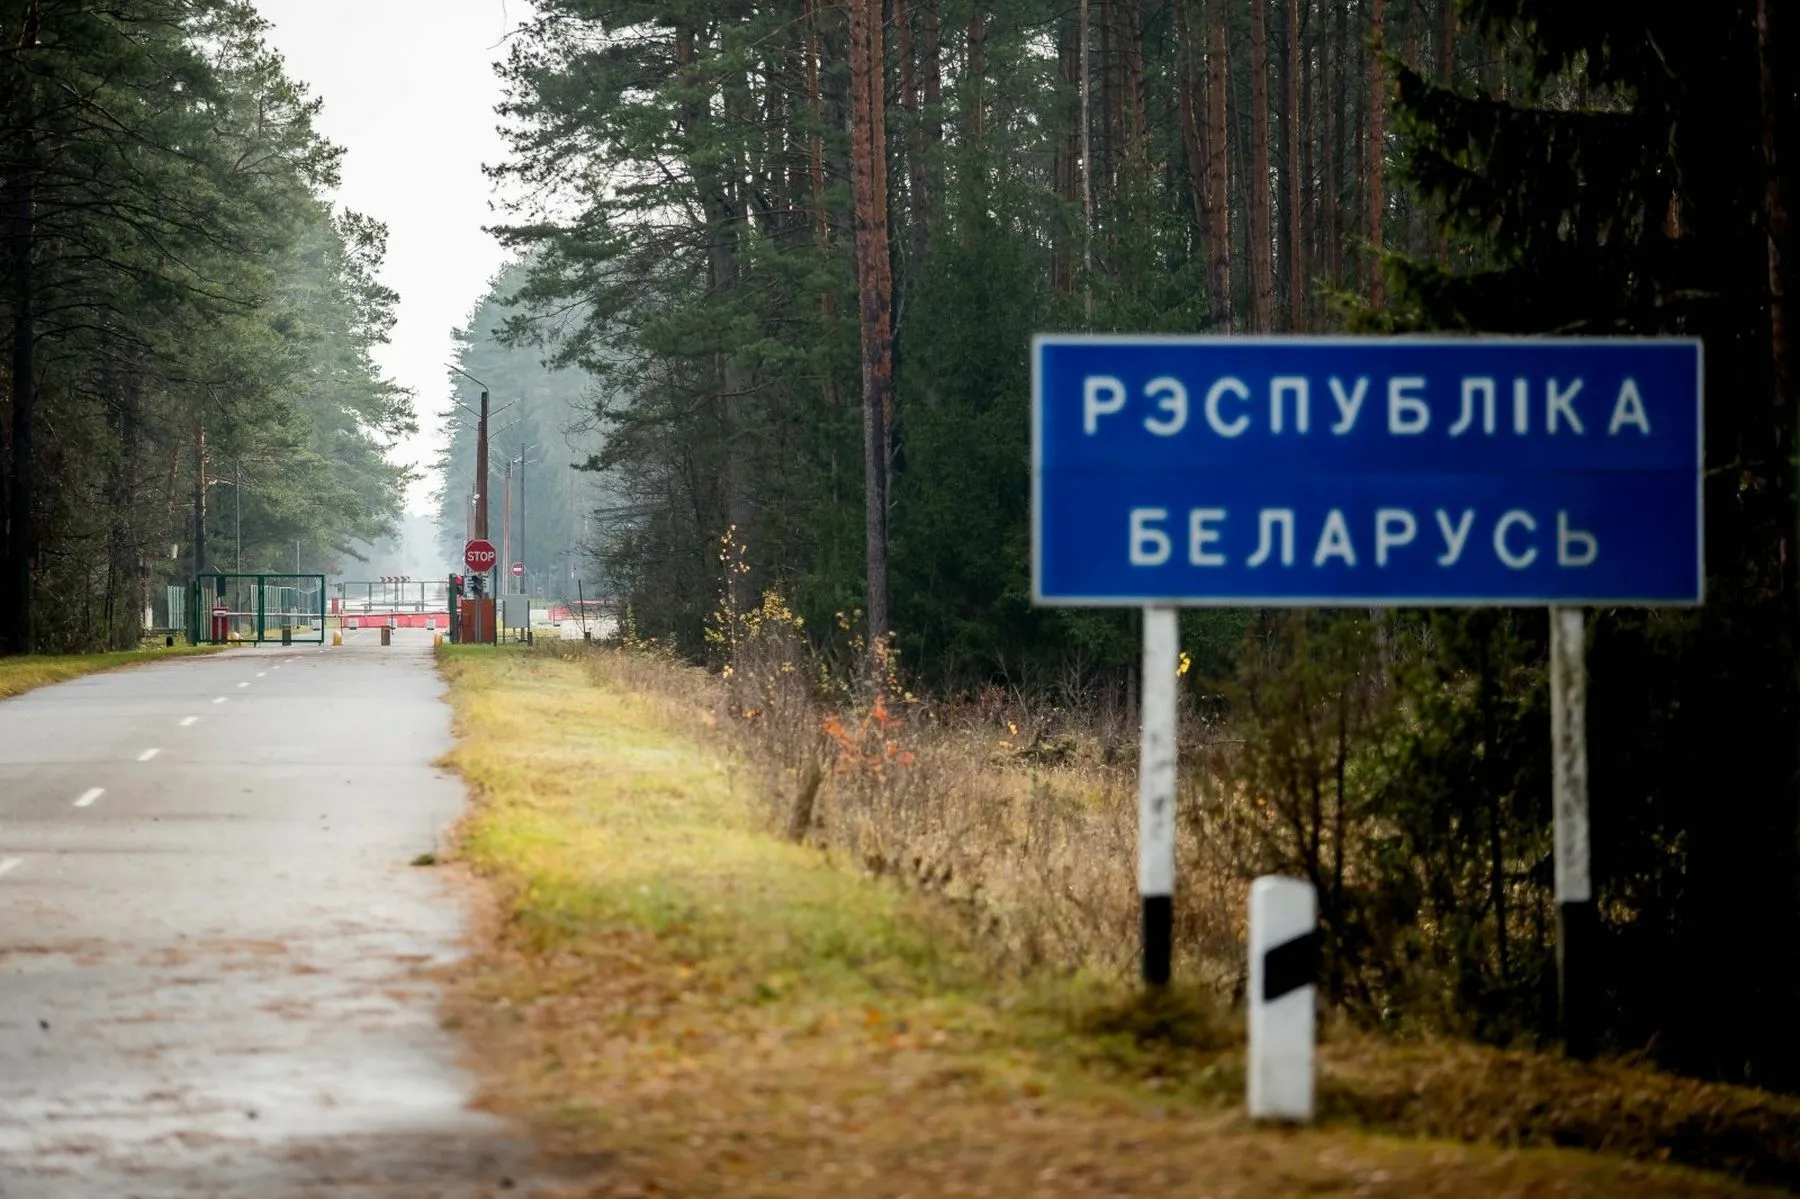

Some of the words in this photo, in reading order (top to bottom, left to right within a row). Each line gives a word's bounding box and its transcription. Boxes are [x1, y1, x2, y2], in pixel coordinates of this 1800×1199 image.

[1083, 376, 1650, 436] РЭСПУБЛІКА
[467, 551, 495, 562] STOP
[1129, 508, 1598, 567] БЕЛАРУСЬ
